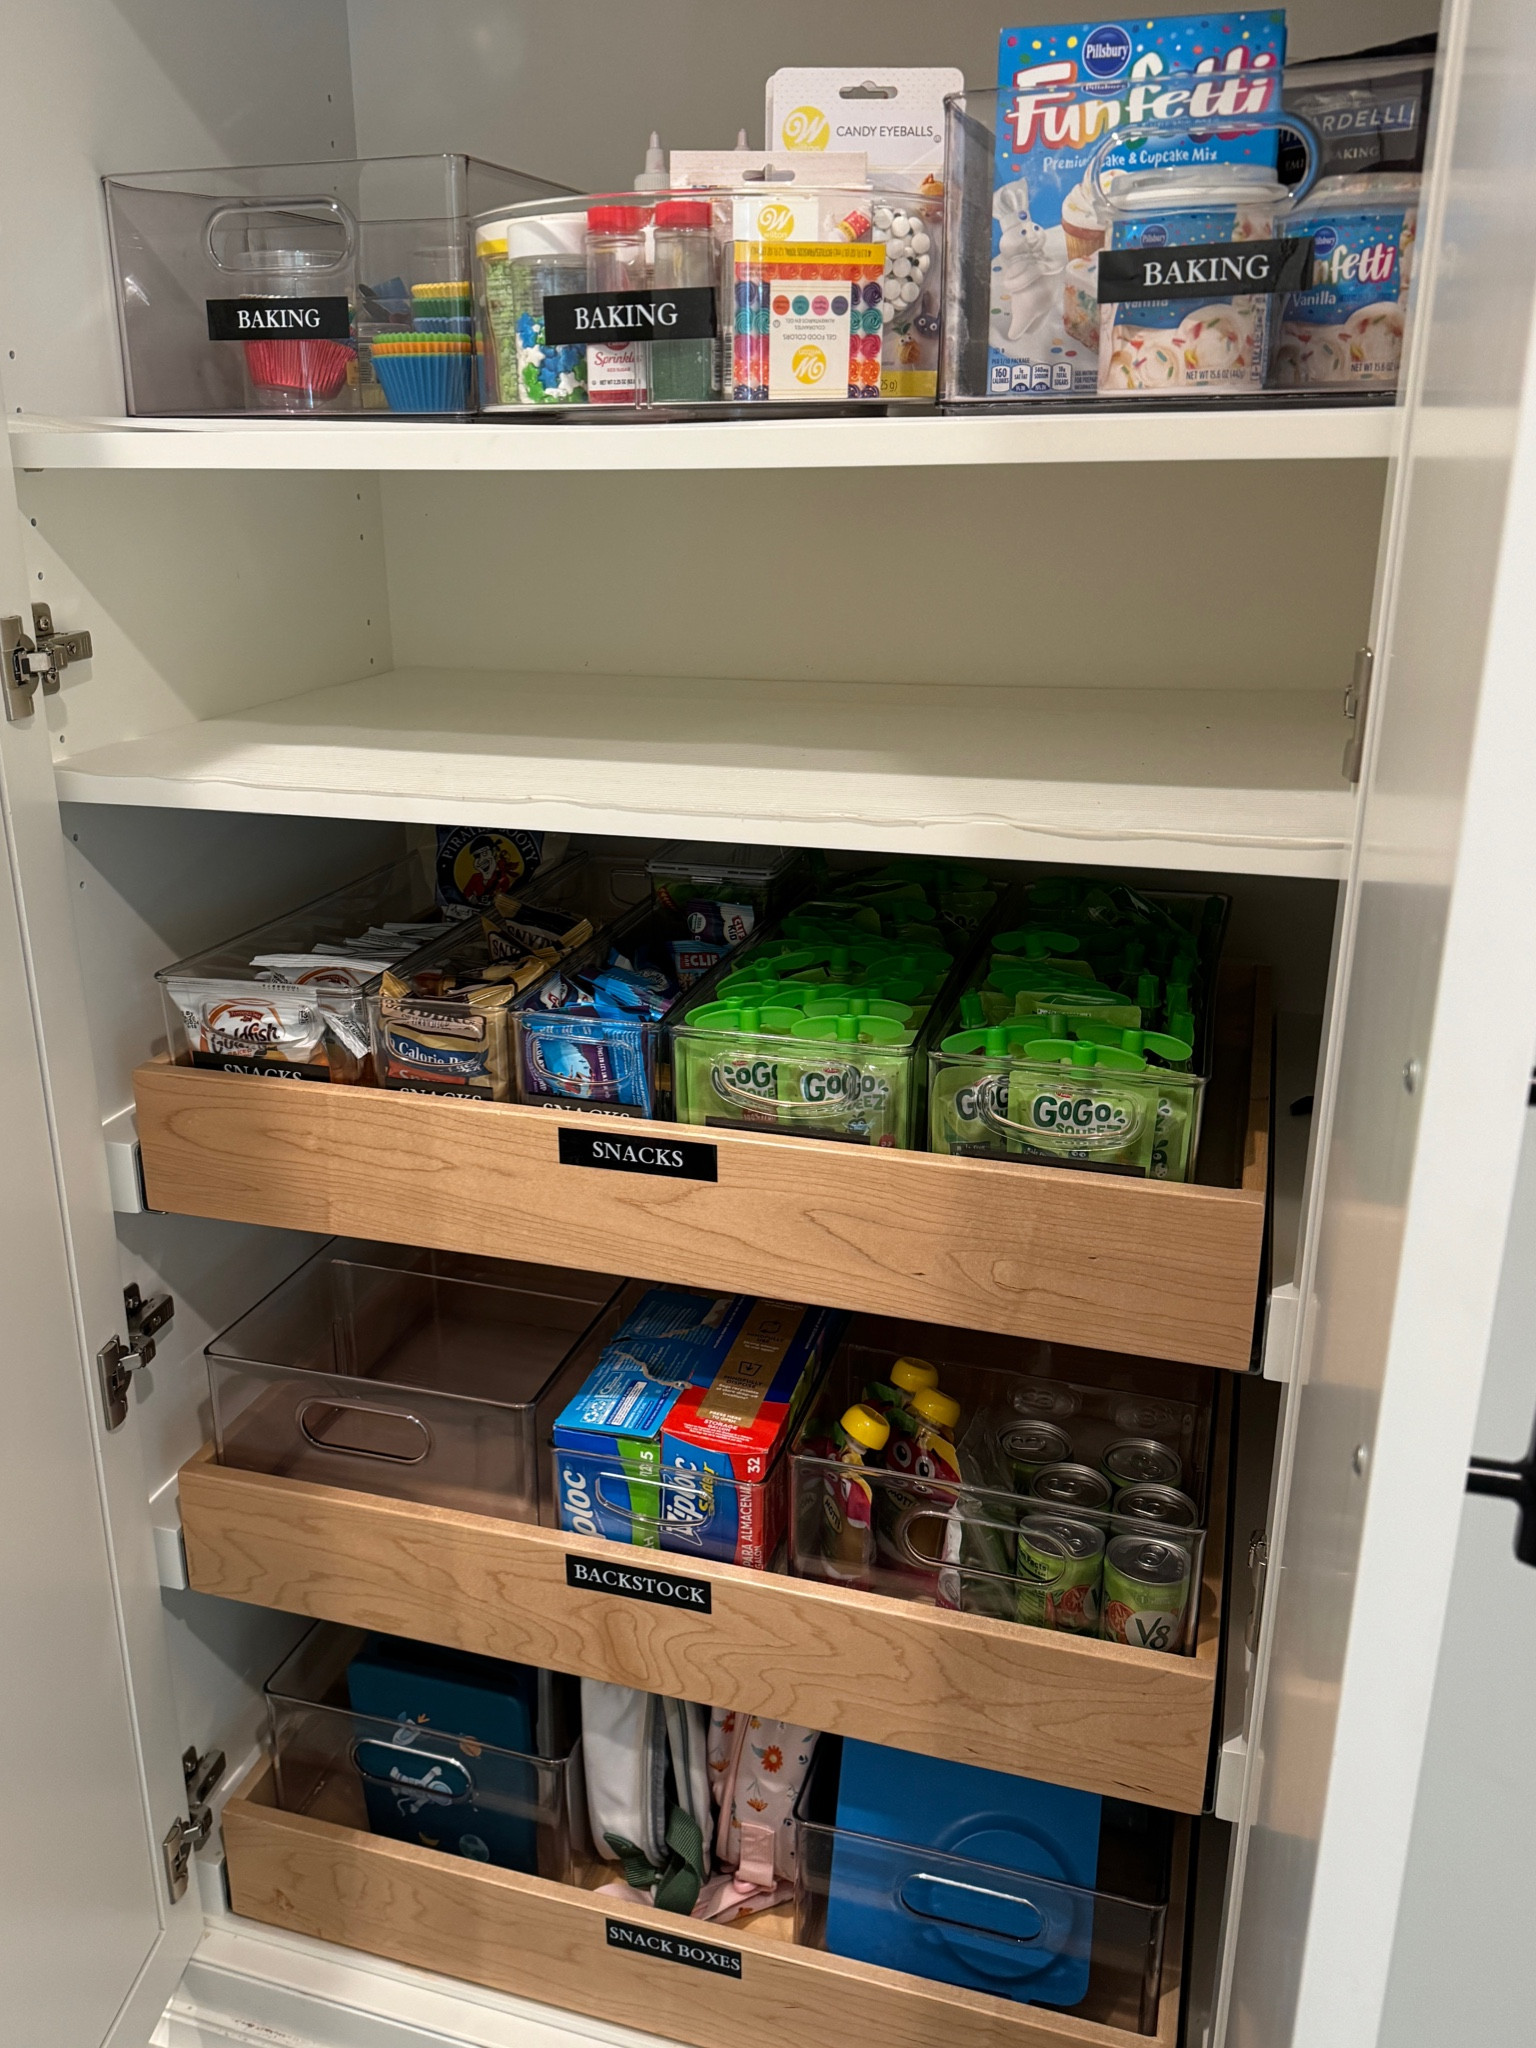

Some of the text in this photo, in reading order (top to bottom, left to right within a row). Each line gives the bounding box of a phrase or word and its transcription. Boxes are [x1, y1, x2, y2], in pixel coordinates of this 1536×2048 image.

[1086, 41, 1129, 62] Pillsbury
[1007, 46, 1277, 147] Funfetti
[836, 125, 933, 137] CANDY EYEBALLS
[1043, 155, 1088, 173] Premiu
[1128, 152, 1137, 164] &
[1139, 150, 1189, 166] Cupcake
[1192, 147, 1218, 161] Mix
[1335, 146, 1379, 159] AKING
[1143, 254, 1271, 287] BAKING
[1313, 243, 1396, 284] nfetti
[1293, 290, 1337, 307] Vanilla
[237, 308, 320, 329] BAKING
[574, 302, 679, 330] BAKING
[782, 333, 837, 341] GEL FOOD COLORS
[594, 351, 643, 367] Sprinkl
[1351, 363, 1363, 372] NET
[1363, 362, 1373, 371] WT
[1374, 362, 1385, 371] 15.6
[995, 368, 1007, 378] 160
[1186, 370, 1199, 380] NET
[1199, 370, 1209, 380] WT
[1210, 369, 1221, 379] 15.6
[1221, 369, 1229, 379] OZ
[499, 829, 539, 861] OOTY
[1033, 1094, 1112, 1128] GoGo
[592, 1140, 684, 1168] SNACKS
[703, 1419, 739, 1430] STORAGE
[746, 1456, 761, 1474] 32
[563, 1470, 607, 1540] ploc
[740, 1479, 754, 1568] PARA ALMACENA
[573, 1563, 706, 1604] BACKSTOCK
[1135, 1617, 1171, 1650] V8
[609, 1926, 741, 1971] SNACK BOXES
